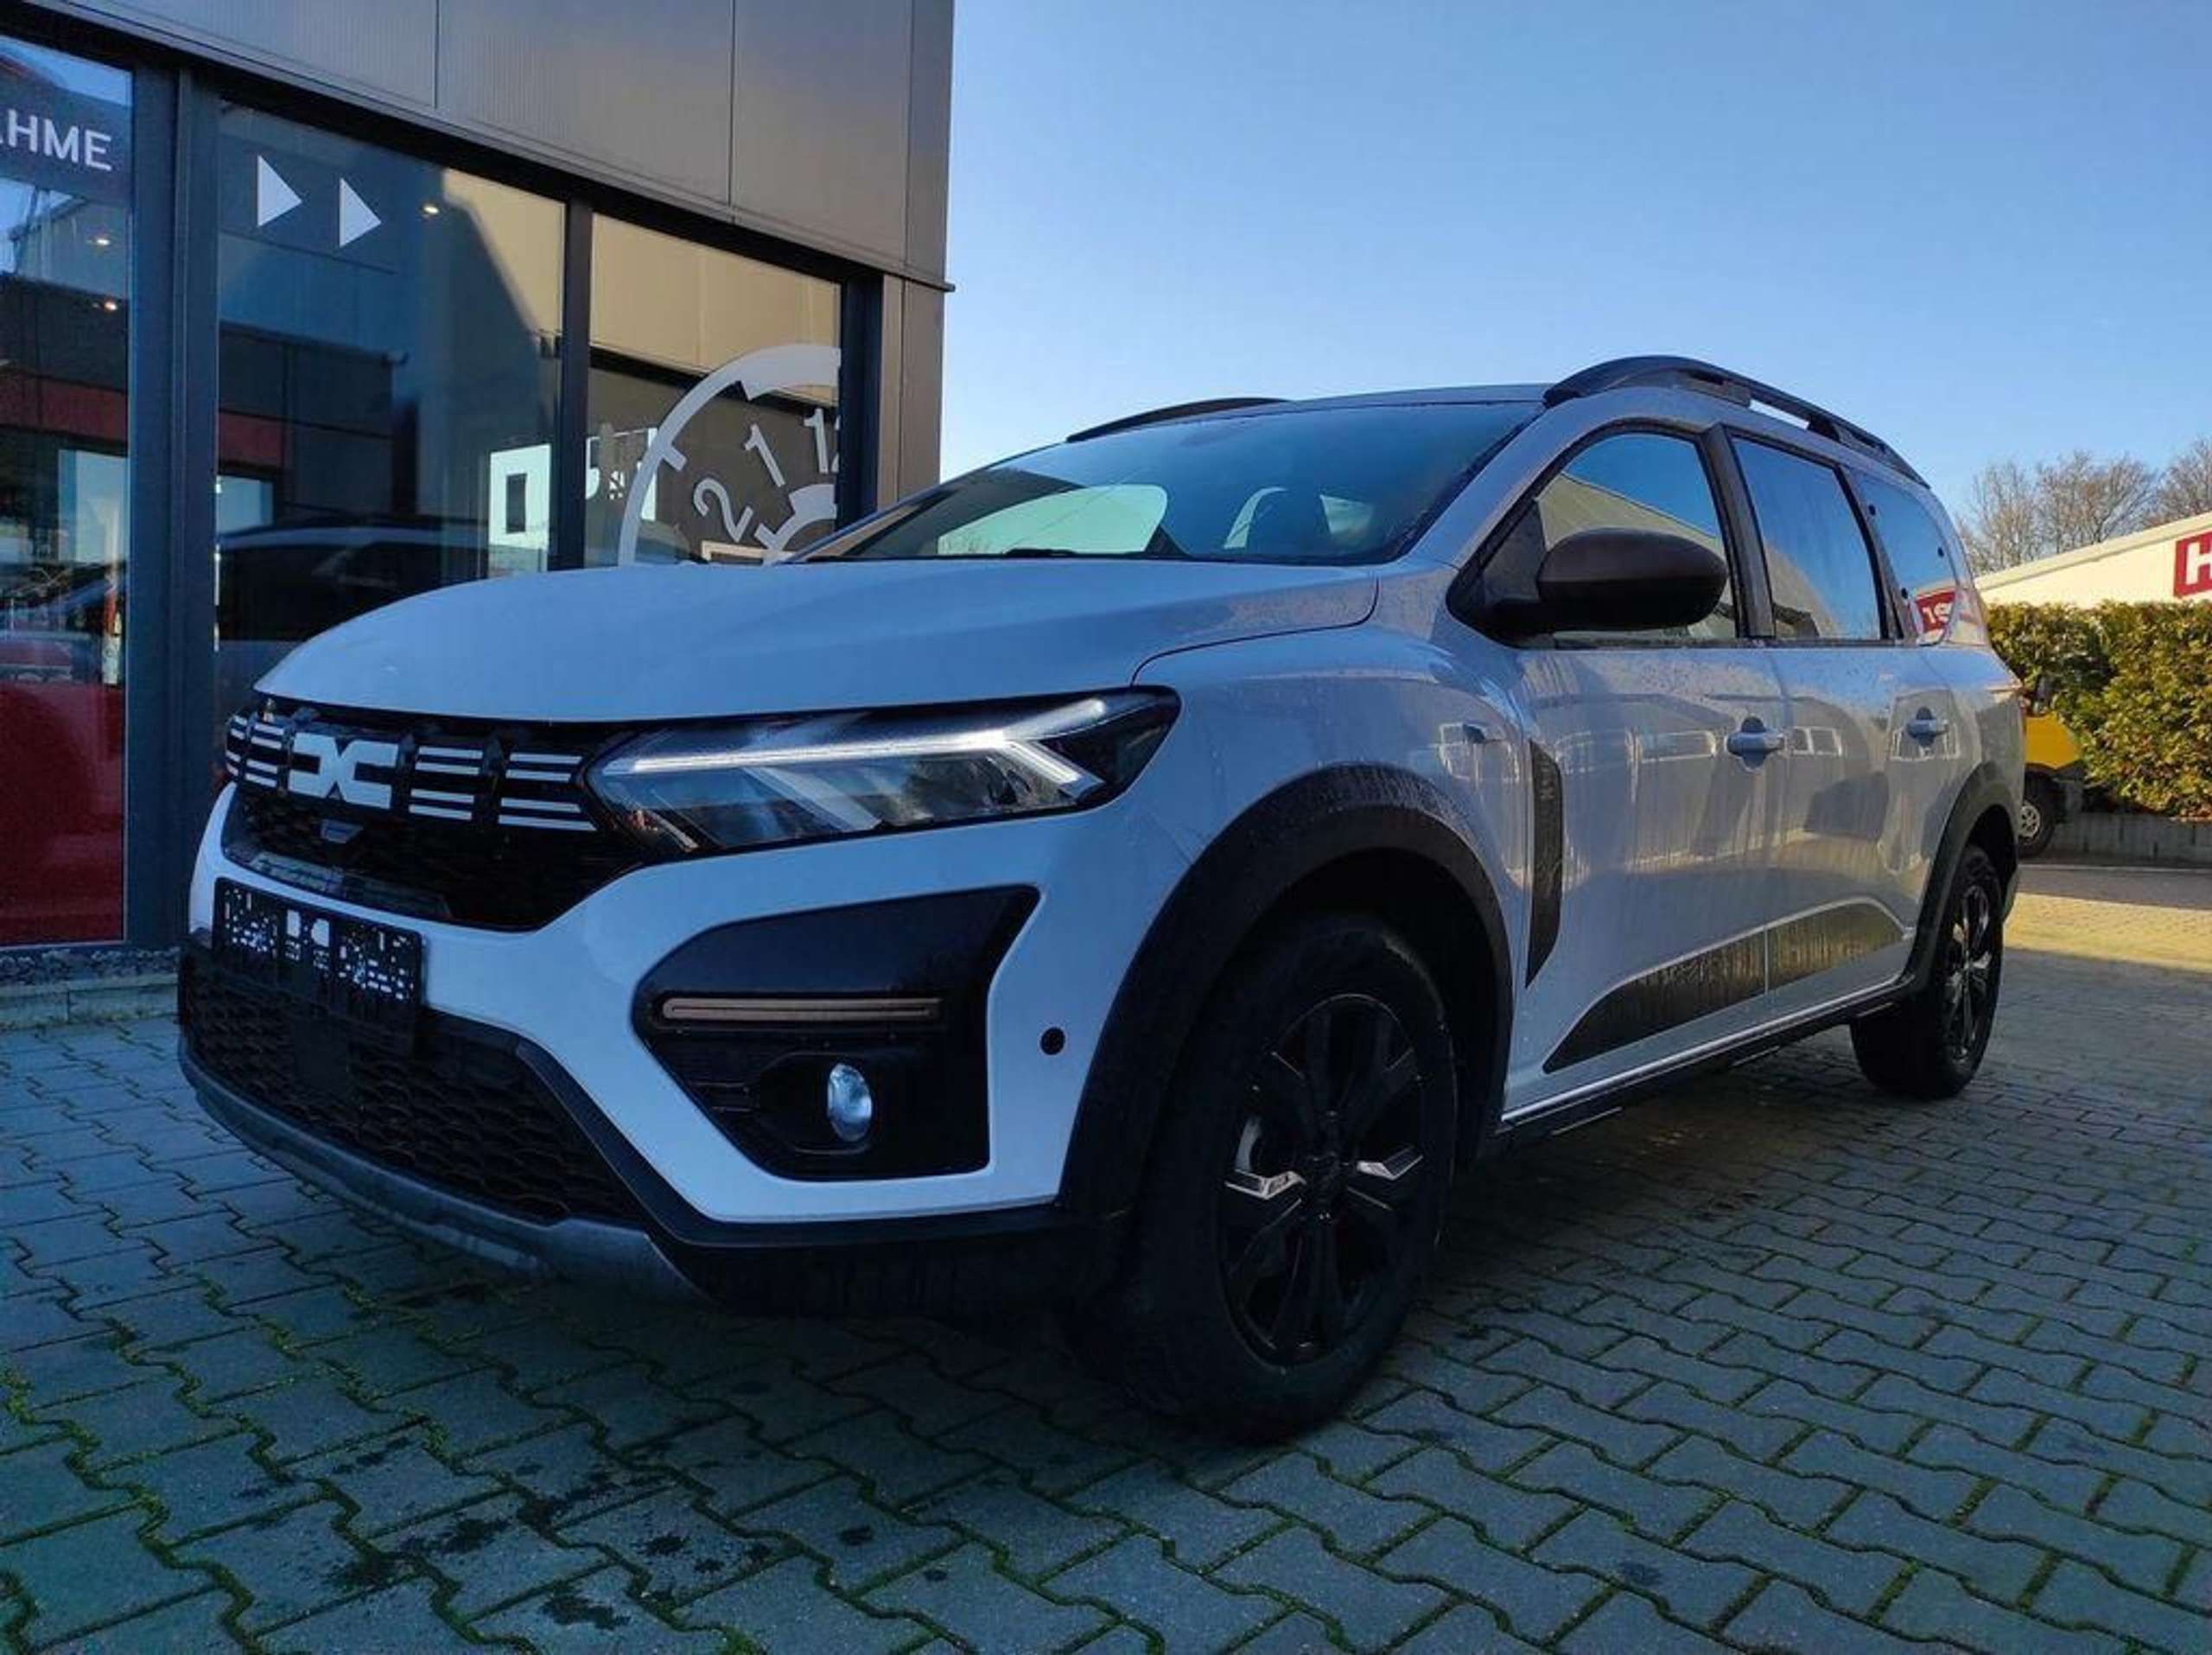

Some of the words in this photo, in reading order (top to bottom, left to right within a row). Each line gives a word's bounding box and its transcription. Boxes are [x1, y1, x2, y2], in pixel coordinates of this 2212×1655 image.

[0, 108, 111, 171] HME
[804, 408, 840, 474] 1
[693, 477, 754, 543] 2
